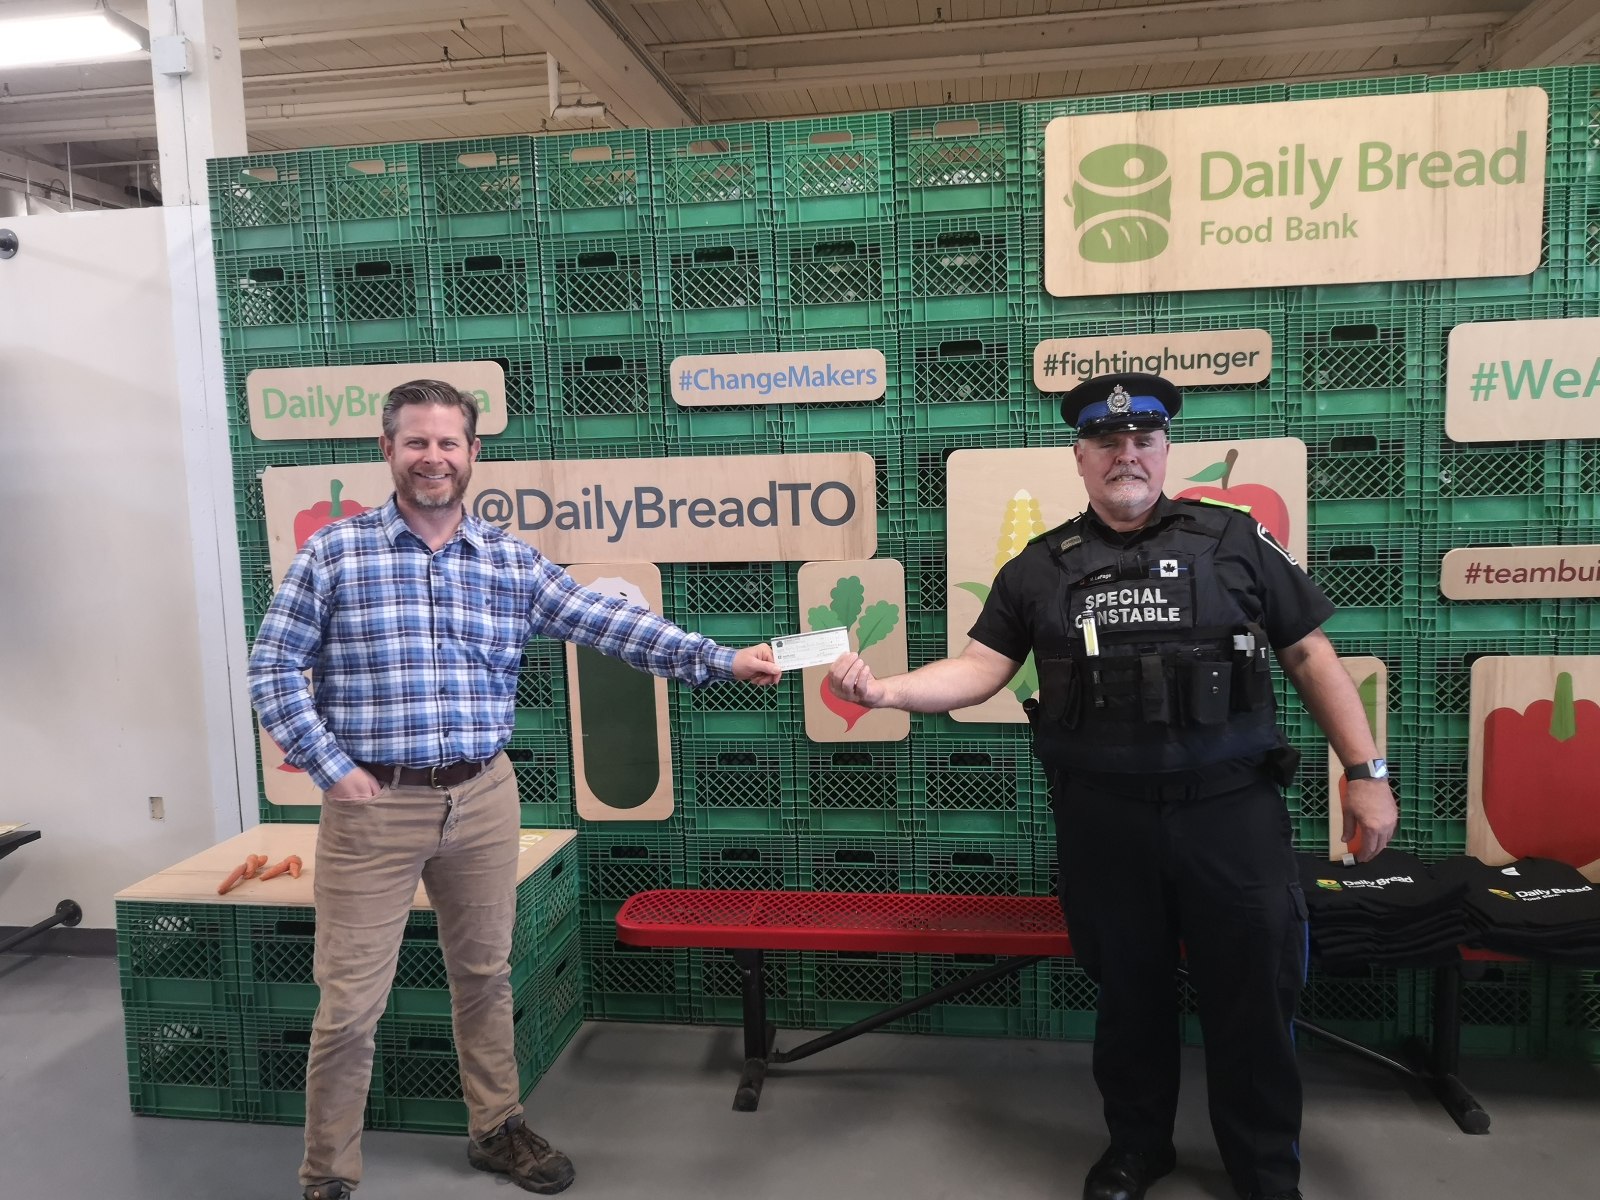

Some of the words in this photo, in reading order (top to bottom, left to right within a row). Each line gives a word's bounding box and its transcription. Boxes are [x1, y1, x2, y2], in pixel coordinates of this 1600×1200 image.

[1200, 143, 1343, 210] Daily
[1358, 131, 1527, 193] Bread
[1200, 217, 1273, 245] Food
[1286, 213, 1358, 241] Bank
[679, 363, 877, 395] #ChangeMakers
[1043, 347, 1260, 381] #fightinghunger
[472, 480, 856, 543] @DailyBreadTO
[1085, 588, 1168, 610] SPECIAL
[1075, 607, 1181, 629] CNSTABLE
[1376, 876, 1414, 886] Bread
[1515, 889, 1550, 898] Daily
[1551, 886, 1592, 894] Bread
